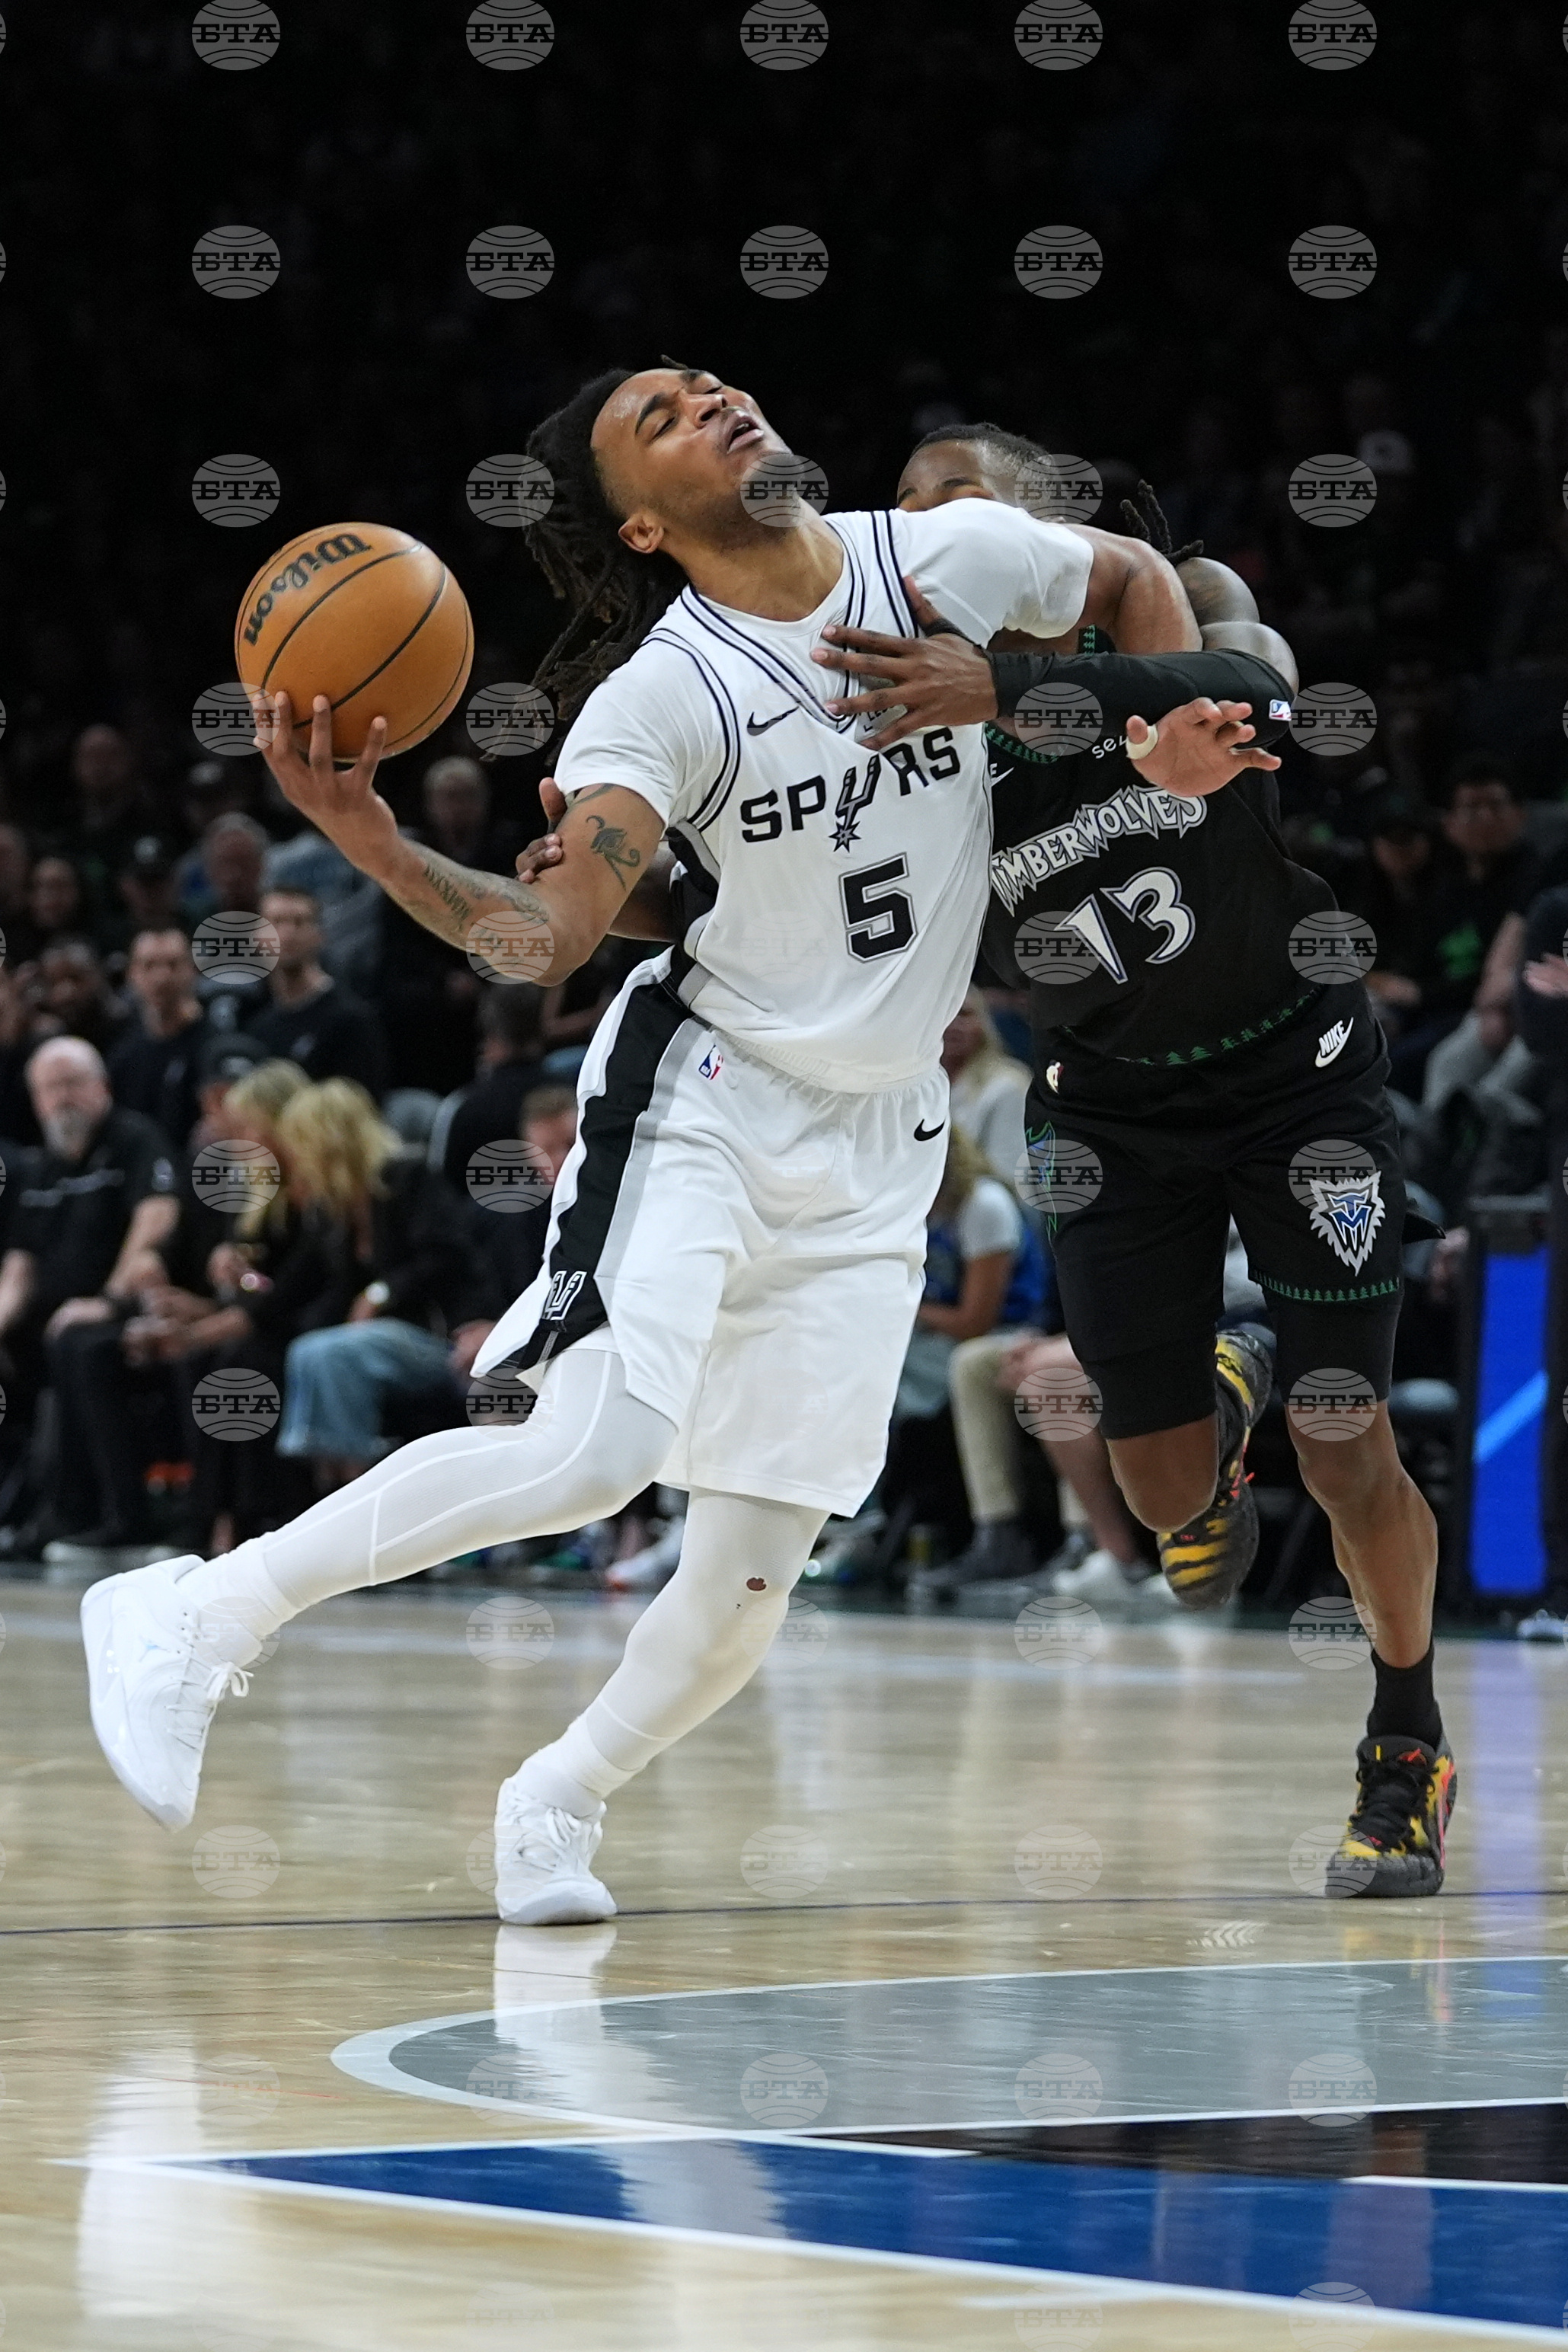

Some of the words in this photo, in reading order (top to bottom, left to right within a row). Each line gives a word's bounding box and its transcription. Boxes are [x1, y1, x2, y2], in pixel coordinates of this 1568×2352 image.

[244, 534, 373, 646] Wilson
[740, 727, 960, 853] SPURS
[838, 852, 918, 962] 5
[1054, 866, 1196, 984] 13
[1318, 1020, 1343, 1056] NIKE
